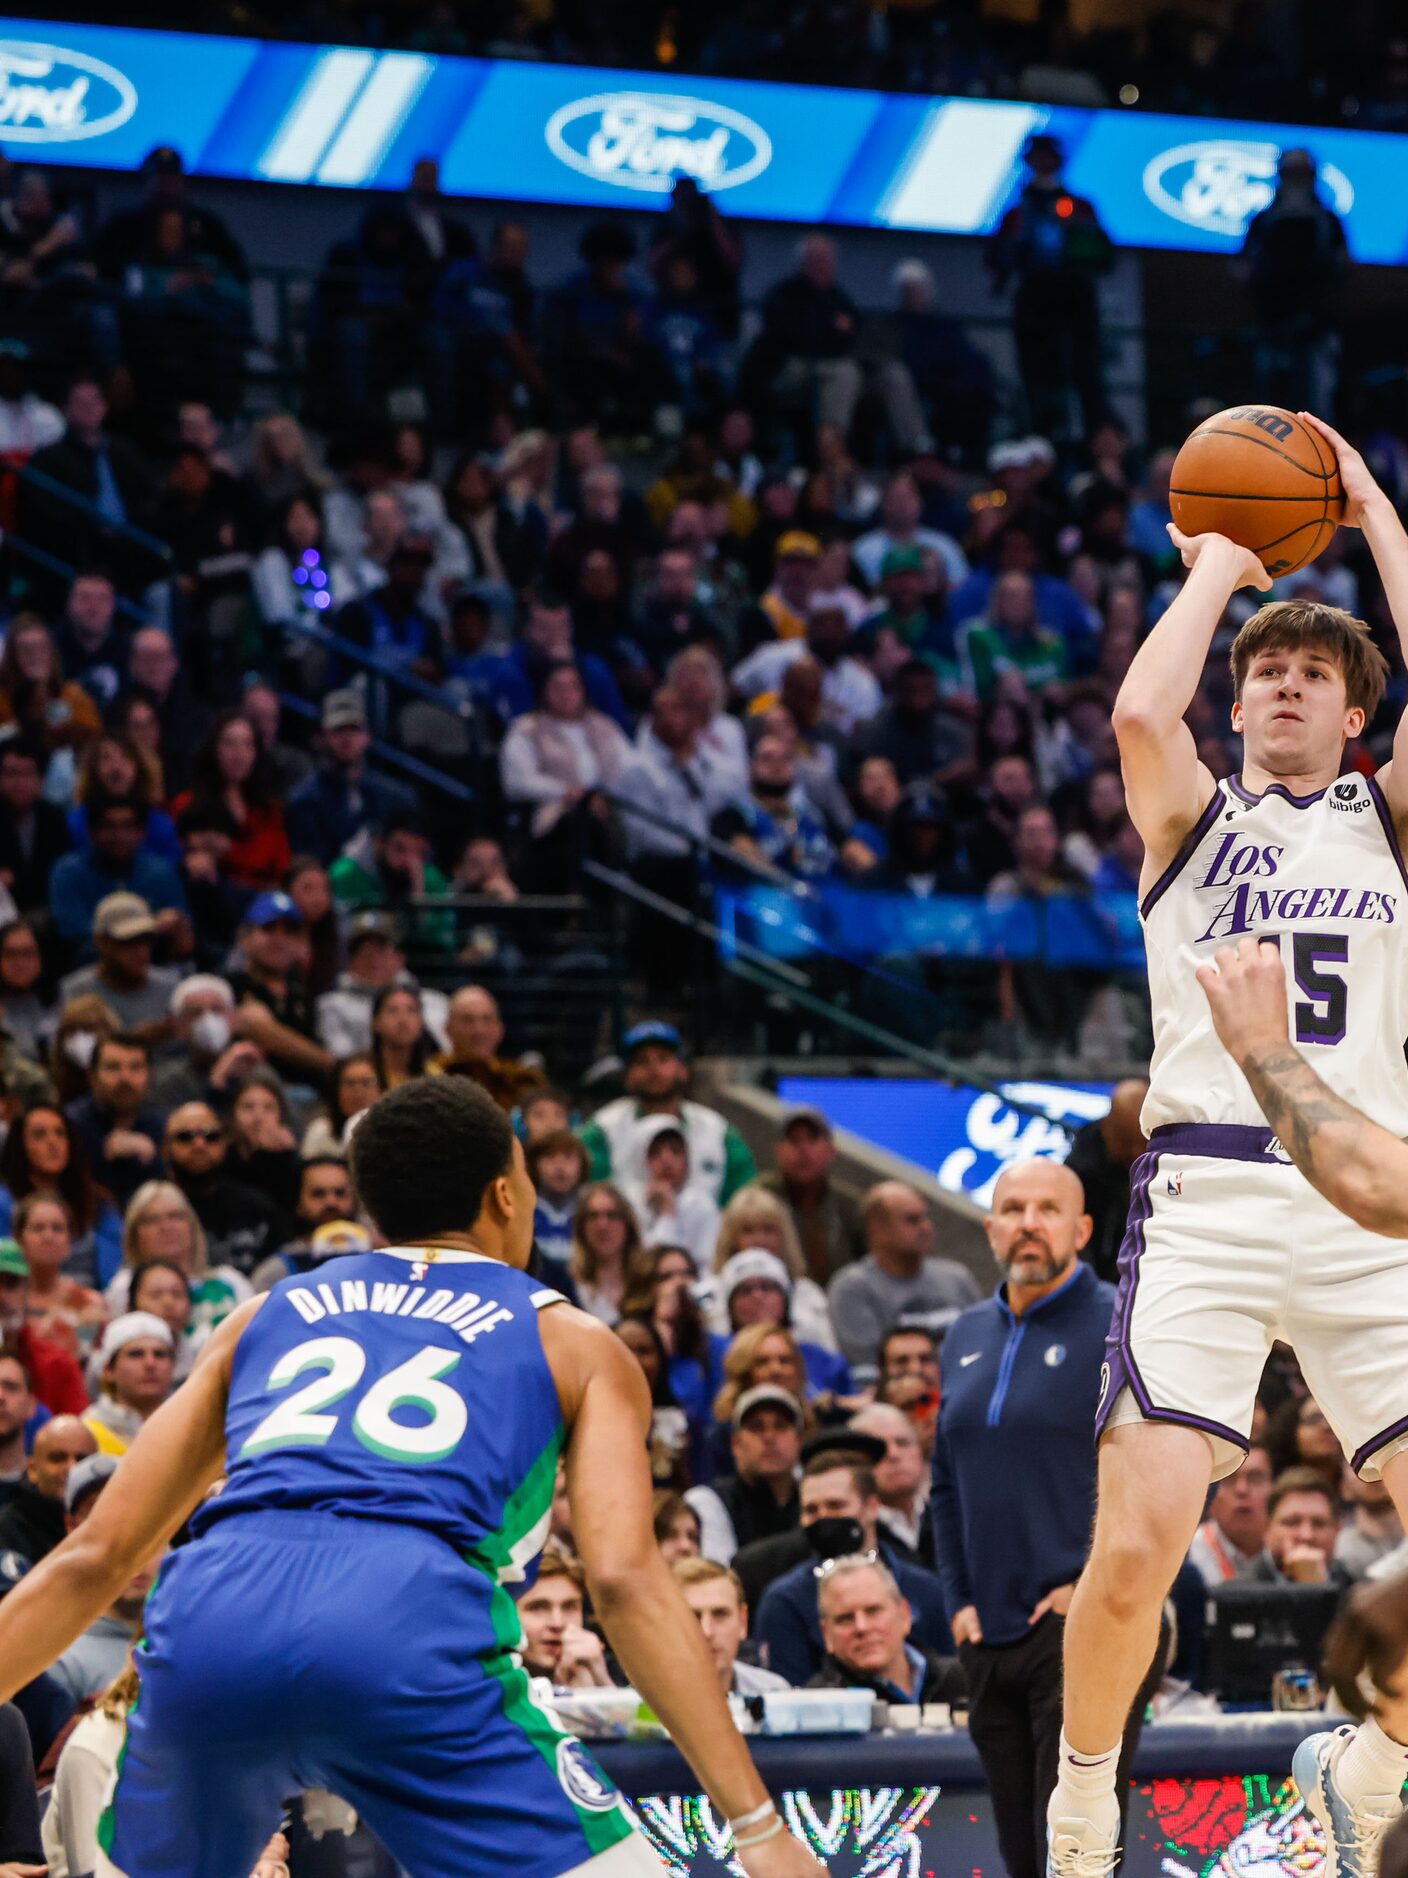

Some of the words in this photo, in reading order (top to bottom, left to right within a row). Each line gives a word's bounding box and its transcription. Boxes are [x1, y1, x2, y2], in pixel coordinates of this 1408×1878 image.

[588, 103, 730, 178] Ford
[1328, 796, 1371, 814] bibigo
[1258, 932, 1349, 1045] 5
[286, 1280, 514, 1343] DINWIDDIE
[239, 1336, 468, 1464] 26
